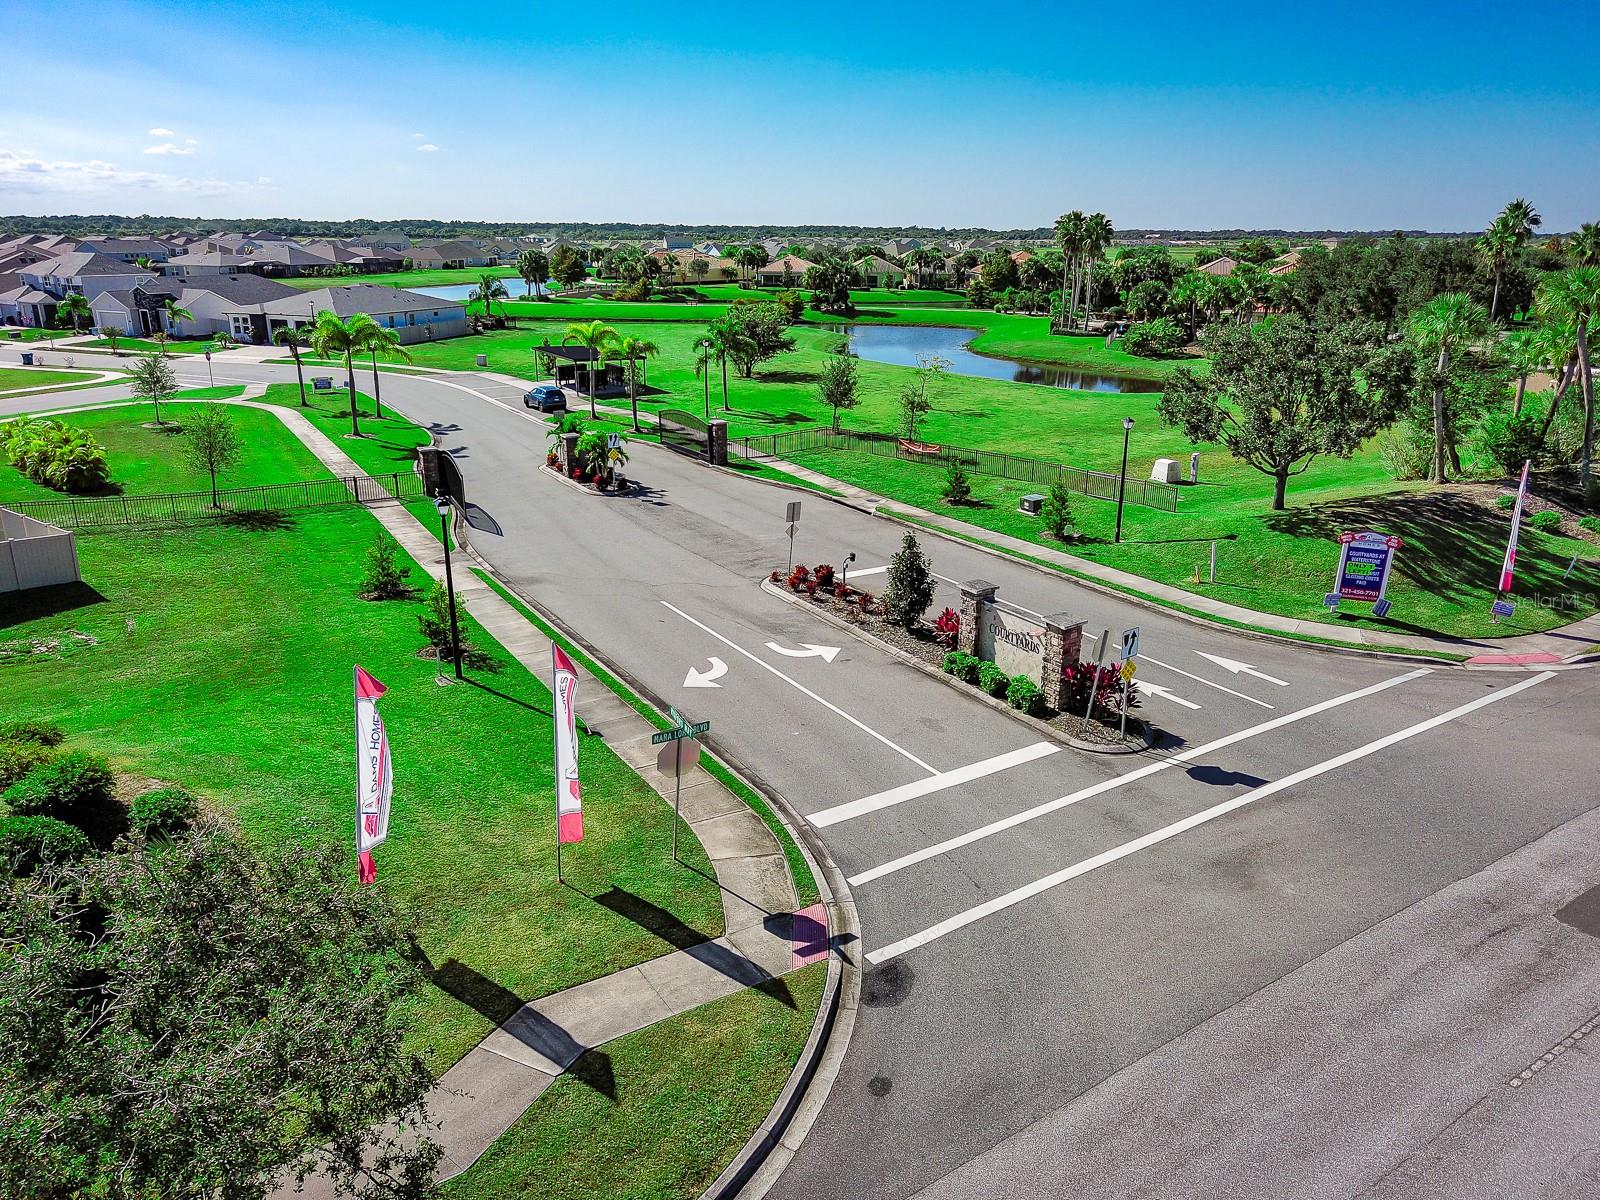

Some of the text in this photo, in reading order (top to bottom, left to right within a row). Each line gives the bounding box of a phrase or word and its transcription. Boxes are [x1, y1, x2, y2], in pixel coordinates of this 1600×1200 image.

[989, 623, 1040, 655] COURTYARDS
[653, 734, 672, 744] MARA
[693, 723, 708, 733] BLVD
